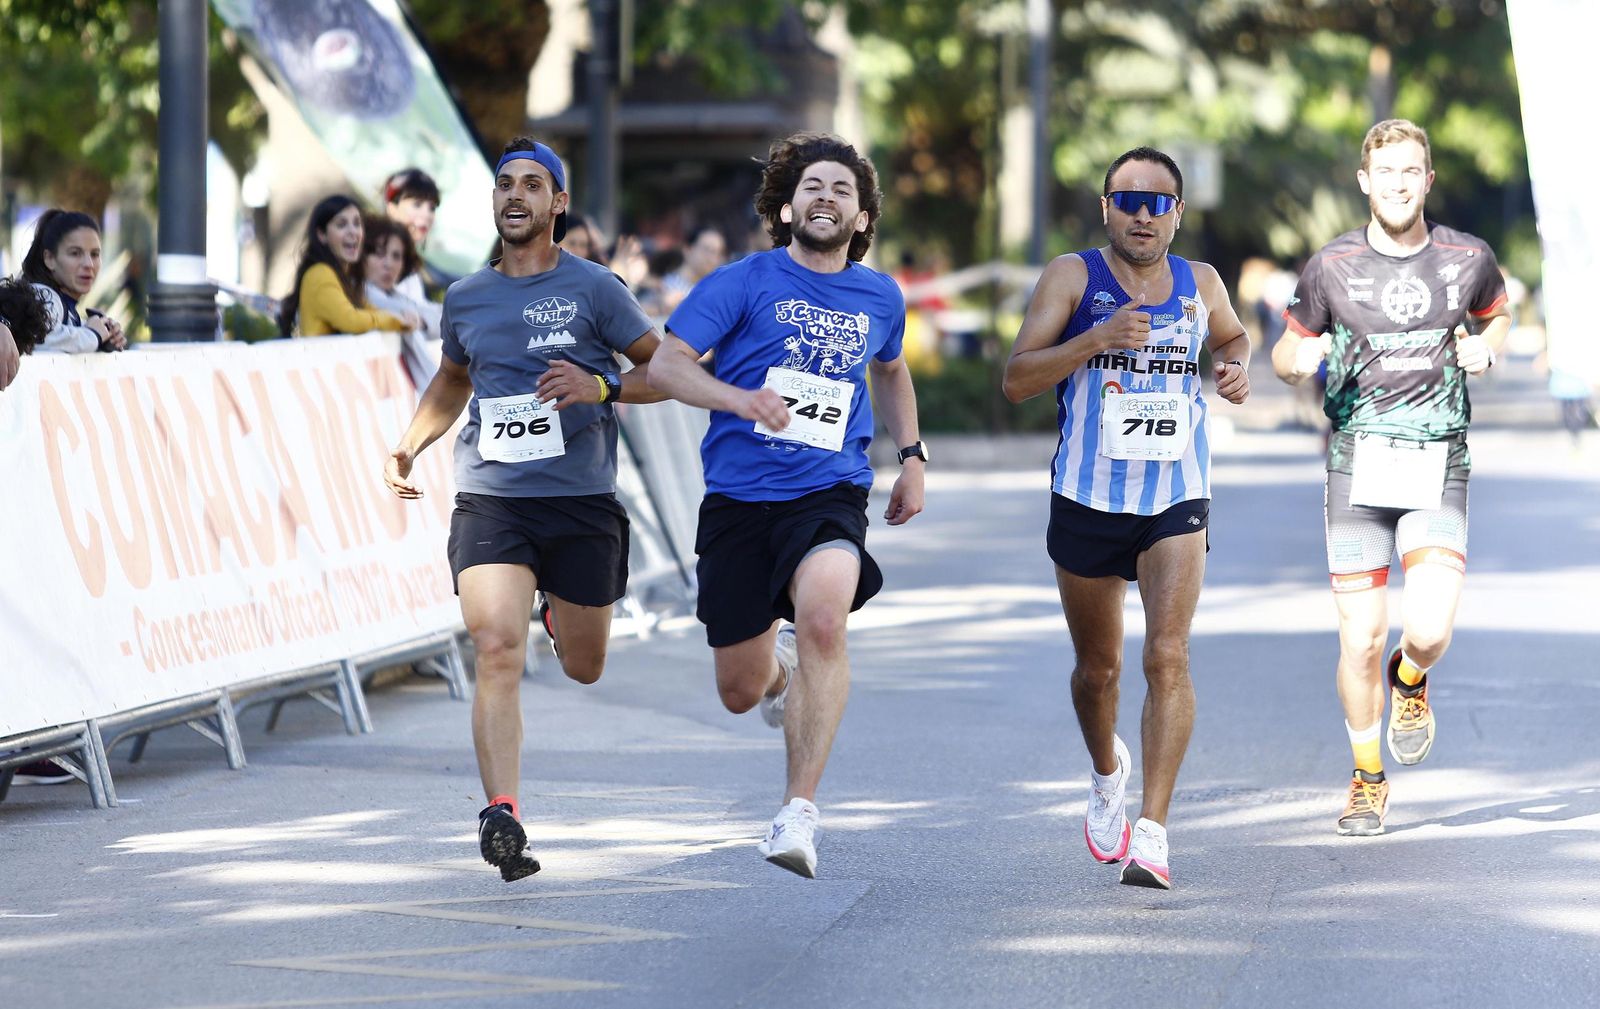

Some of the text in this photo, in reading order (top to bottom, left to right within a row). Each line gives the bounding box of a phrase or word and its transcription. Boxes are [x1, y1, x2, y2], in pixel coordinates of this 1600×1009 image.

[529, 311, 564, 324] TRAIL
[791, 300, 858, 328] Carrera
[806, 319, 860, 344] Prensa
[493, 417, 551, 440] 706
[1122, 418, 1177, 436] 718
[39, 368, 326, 598] CUMACA
[133, 585, 274, 673] Concesionario
[268, 569, 340, 643] Oficial
